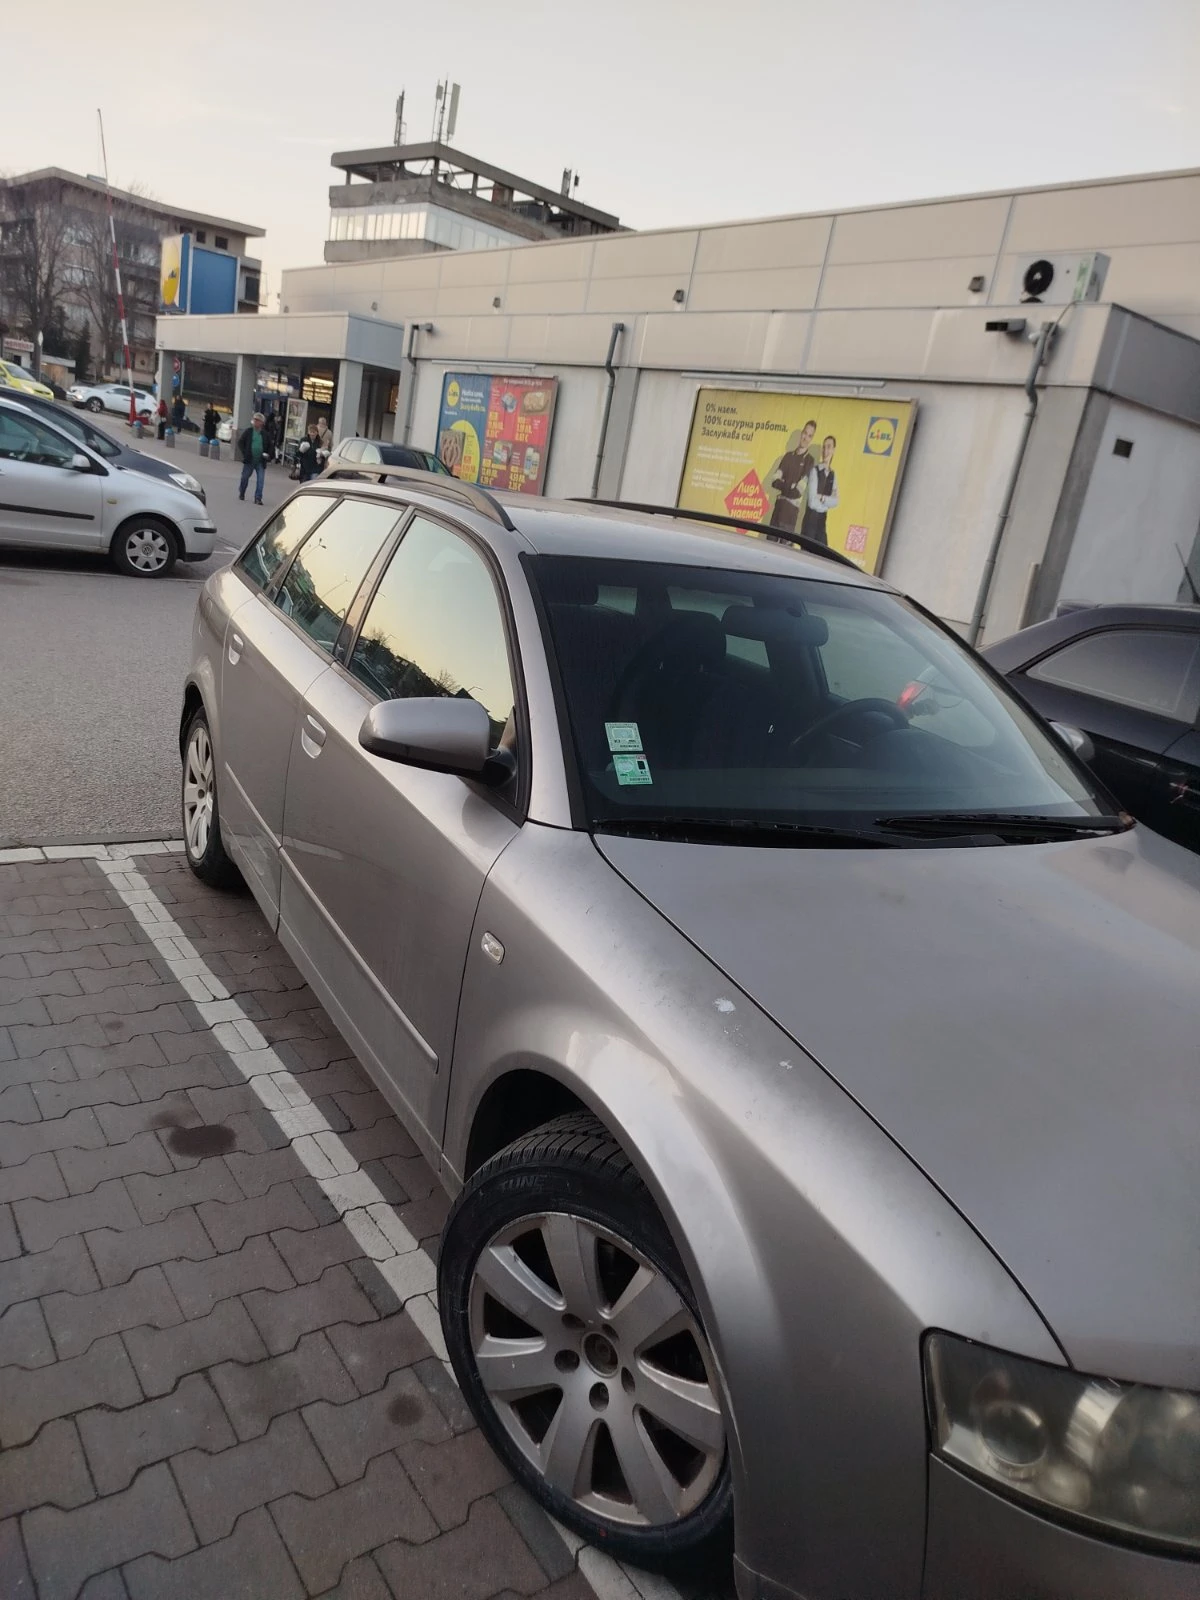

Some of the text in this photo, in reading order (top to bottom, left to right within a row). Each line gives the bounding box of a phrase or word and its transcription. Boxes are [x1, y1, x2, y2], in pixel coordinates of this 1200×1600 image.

[705, 402, 738, 415] 0% наем.
[704, 415, 789, 433] 100% сигурна работа.
[701, 427, 754, 442] Заслужава си!
[737, 482, 760, 497] Лидл
[732, 496, 763, 509] плаща
[730, 509, 762, 519] наема!
